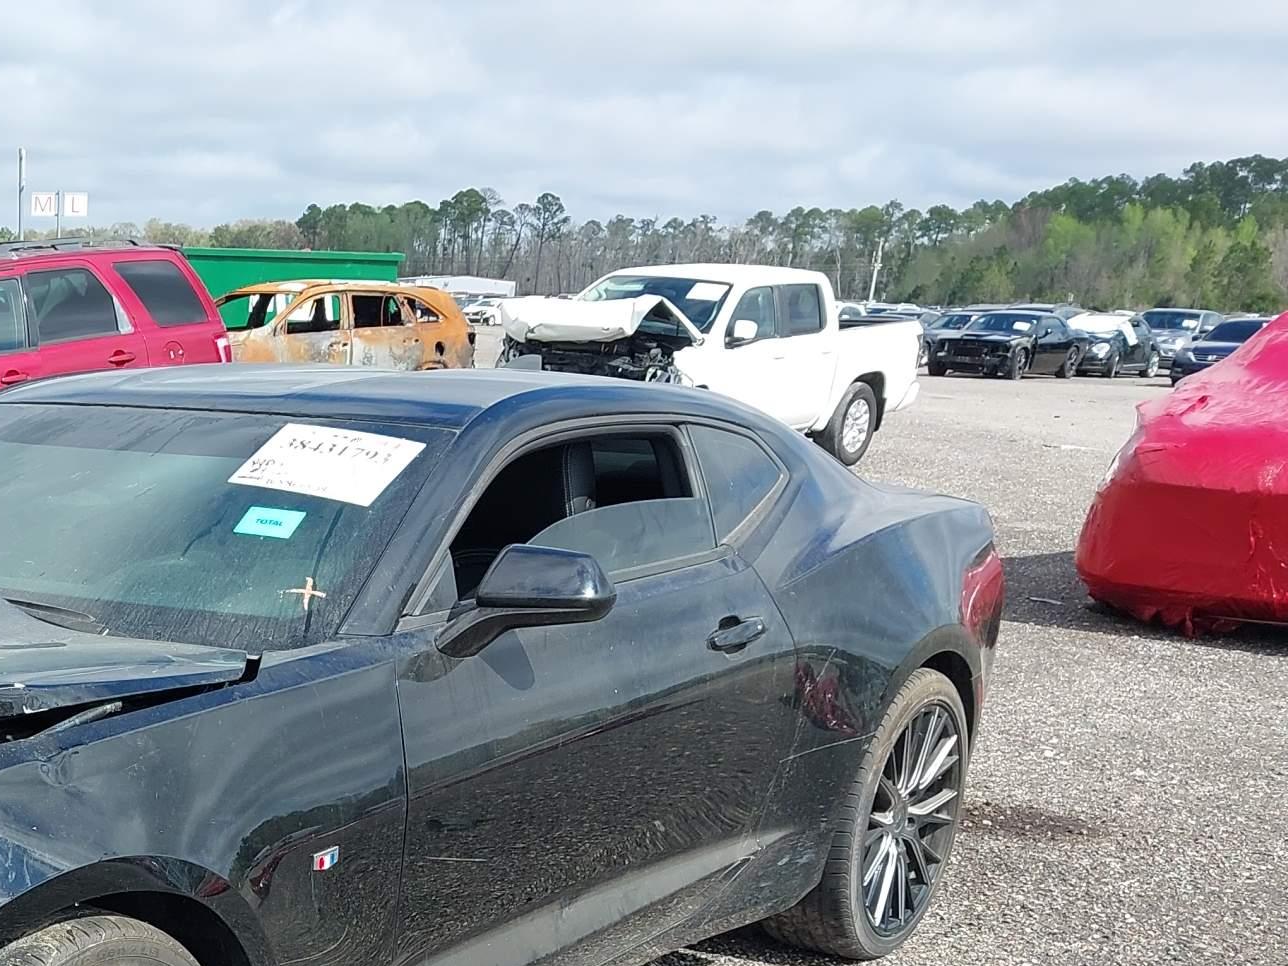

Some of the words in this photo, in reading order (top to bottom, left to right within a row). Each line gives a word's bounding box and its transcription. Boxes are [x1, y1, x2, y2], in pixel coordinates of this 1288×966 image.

[34, 196, 52, 213] M
[71, 196, 81, 213] L
[255, 518, 283, 527] TOTAL
